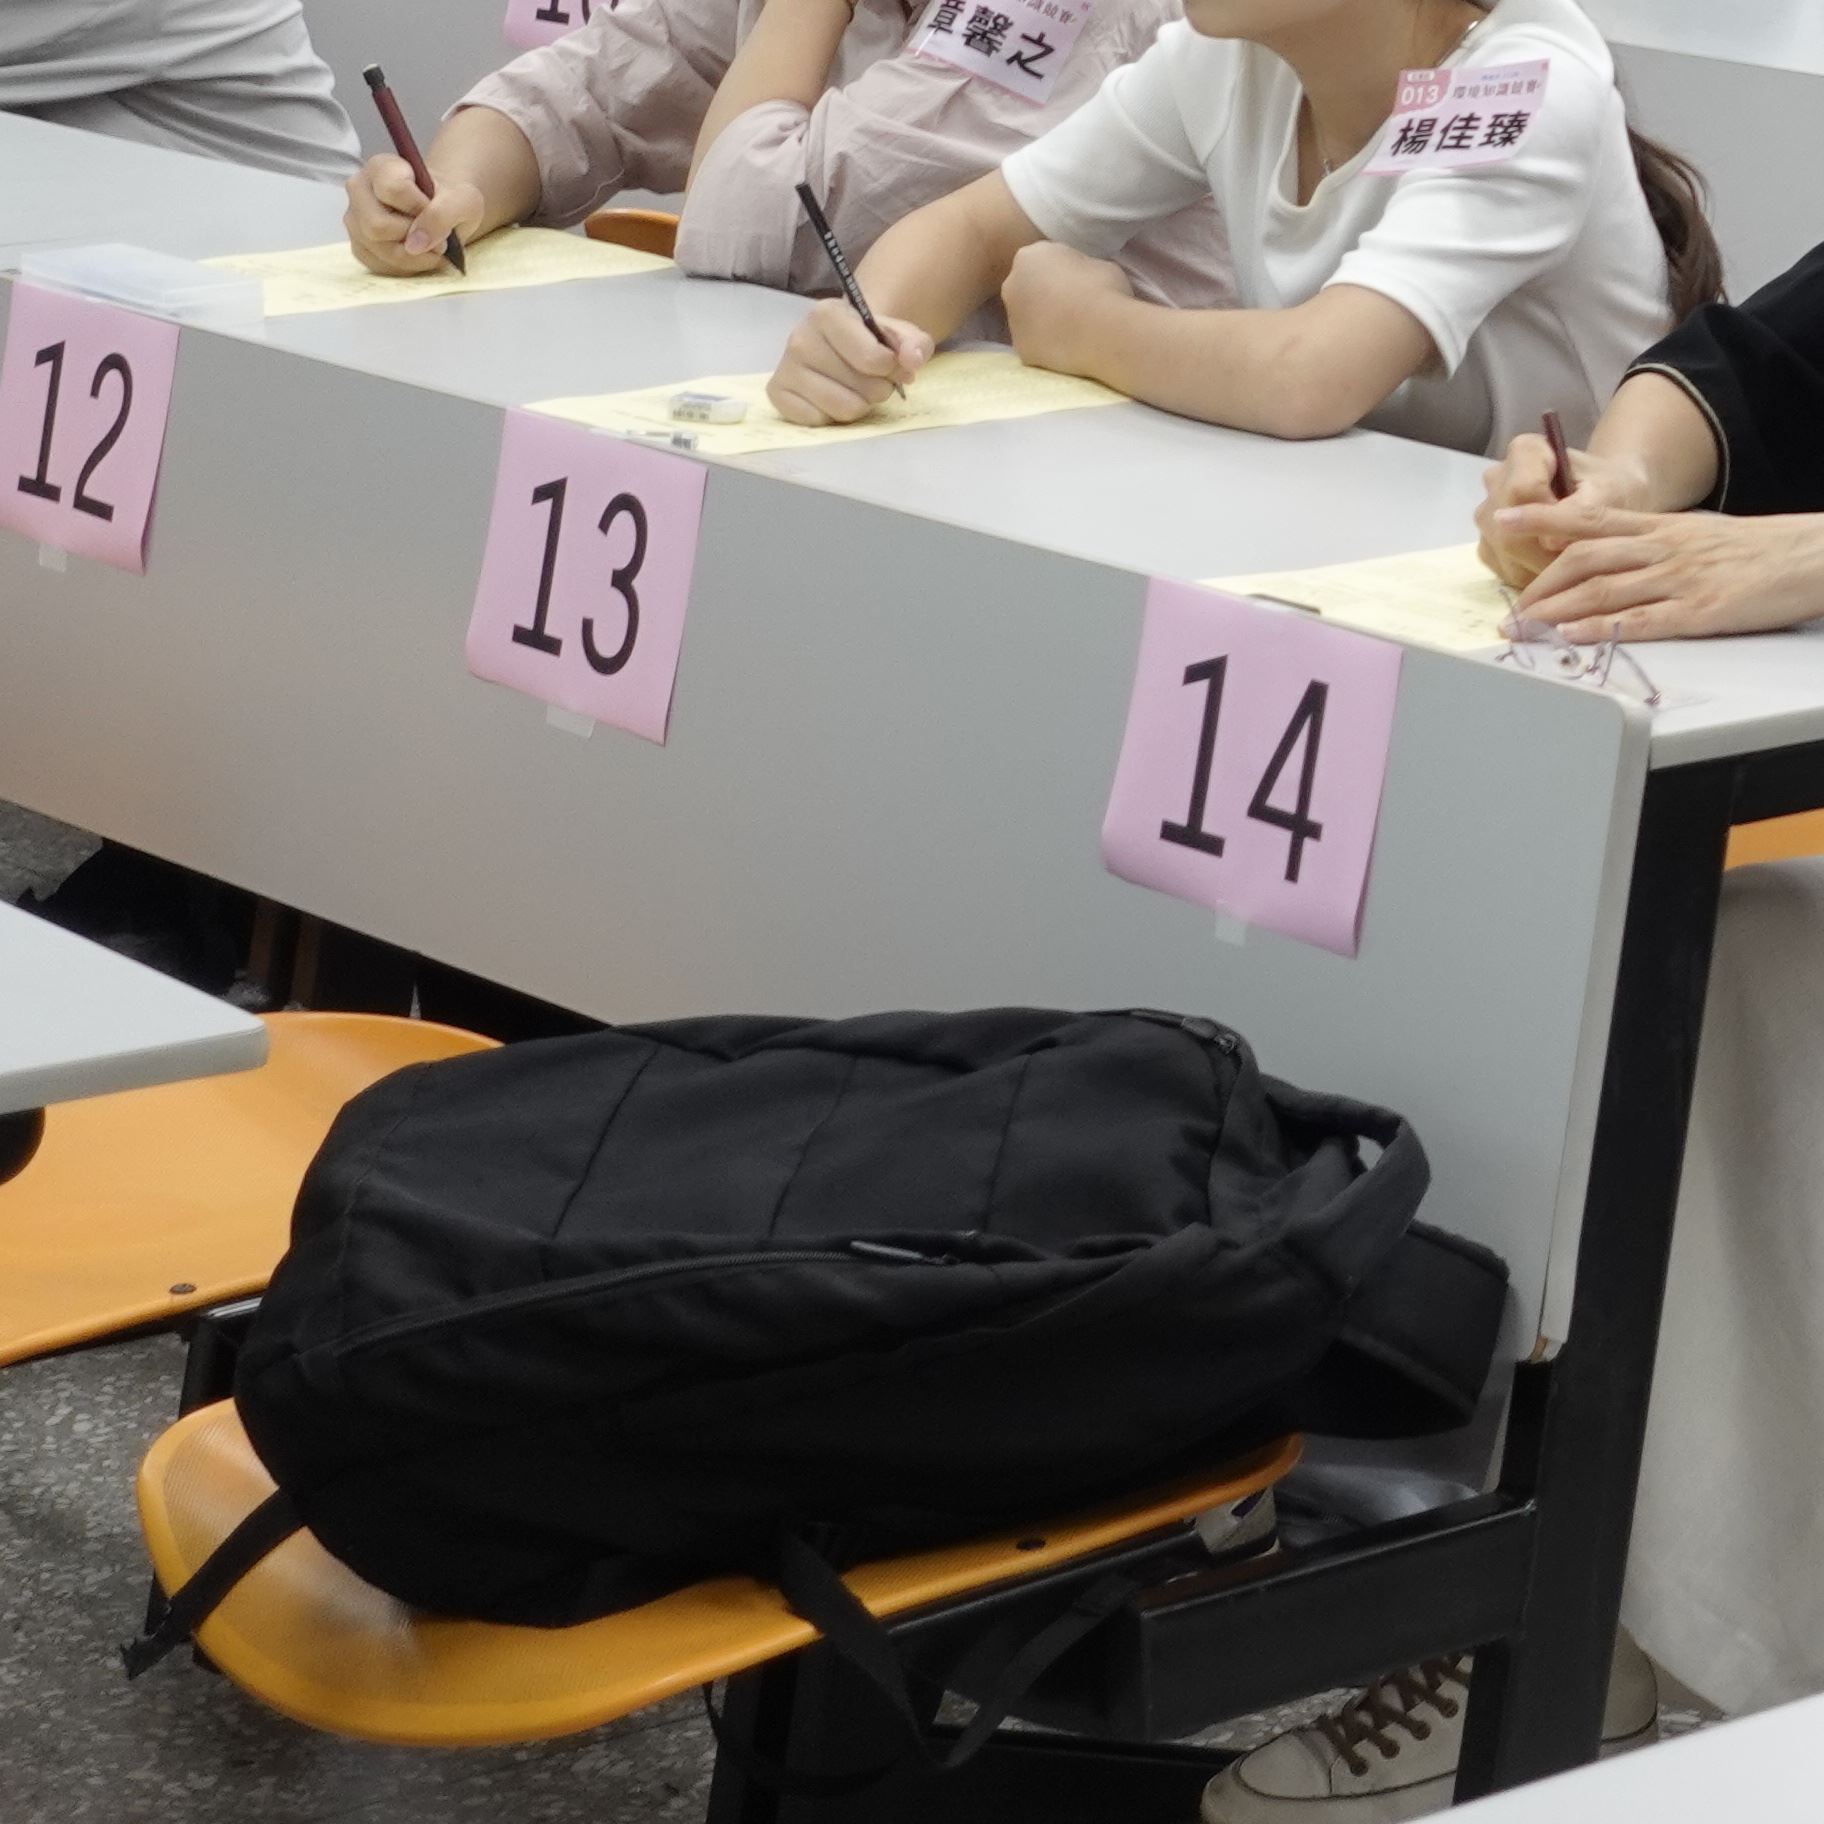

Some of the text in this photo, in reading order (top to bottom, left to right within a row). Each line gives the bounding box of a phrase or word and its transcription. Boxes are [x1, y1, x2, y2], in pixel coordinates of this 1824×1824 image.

[1391, 110, 1532, 157] 楊佳臻
[1401, 84, 1441, 106] 013
[17, 340, 134, 523] 12
[511, 477, 649, 677] 13
[1159, 655, 1329, 884] 14
